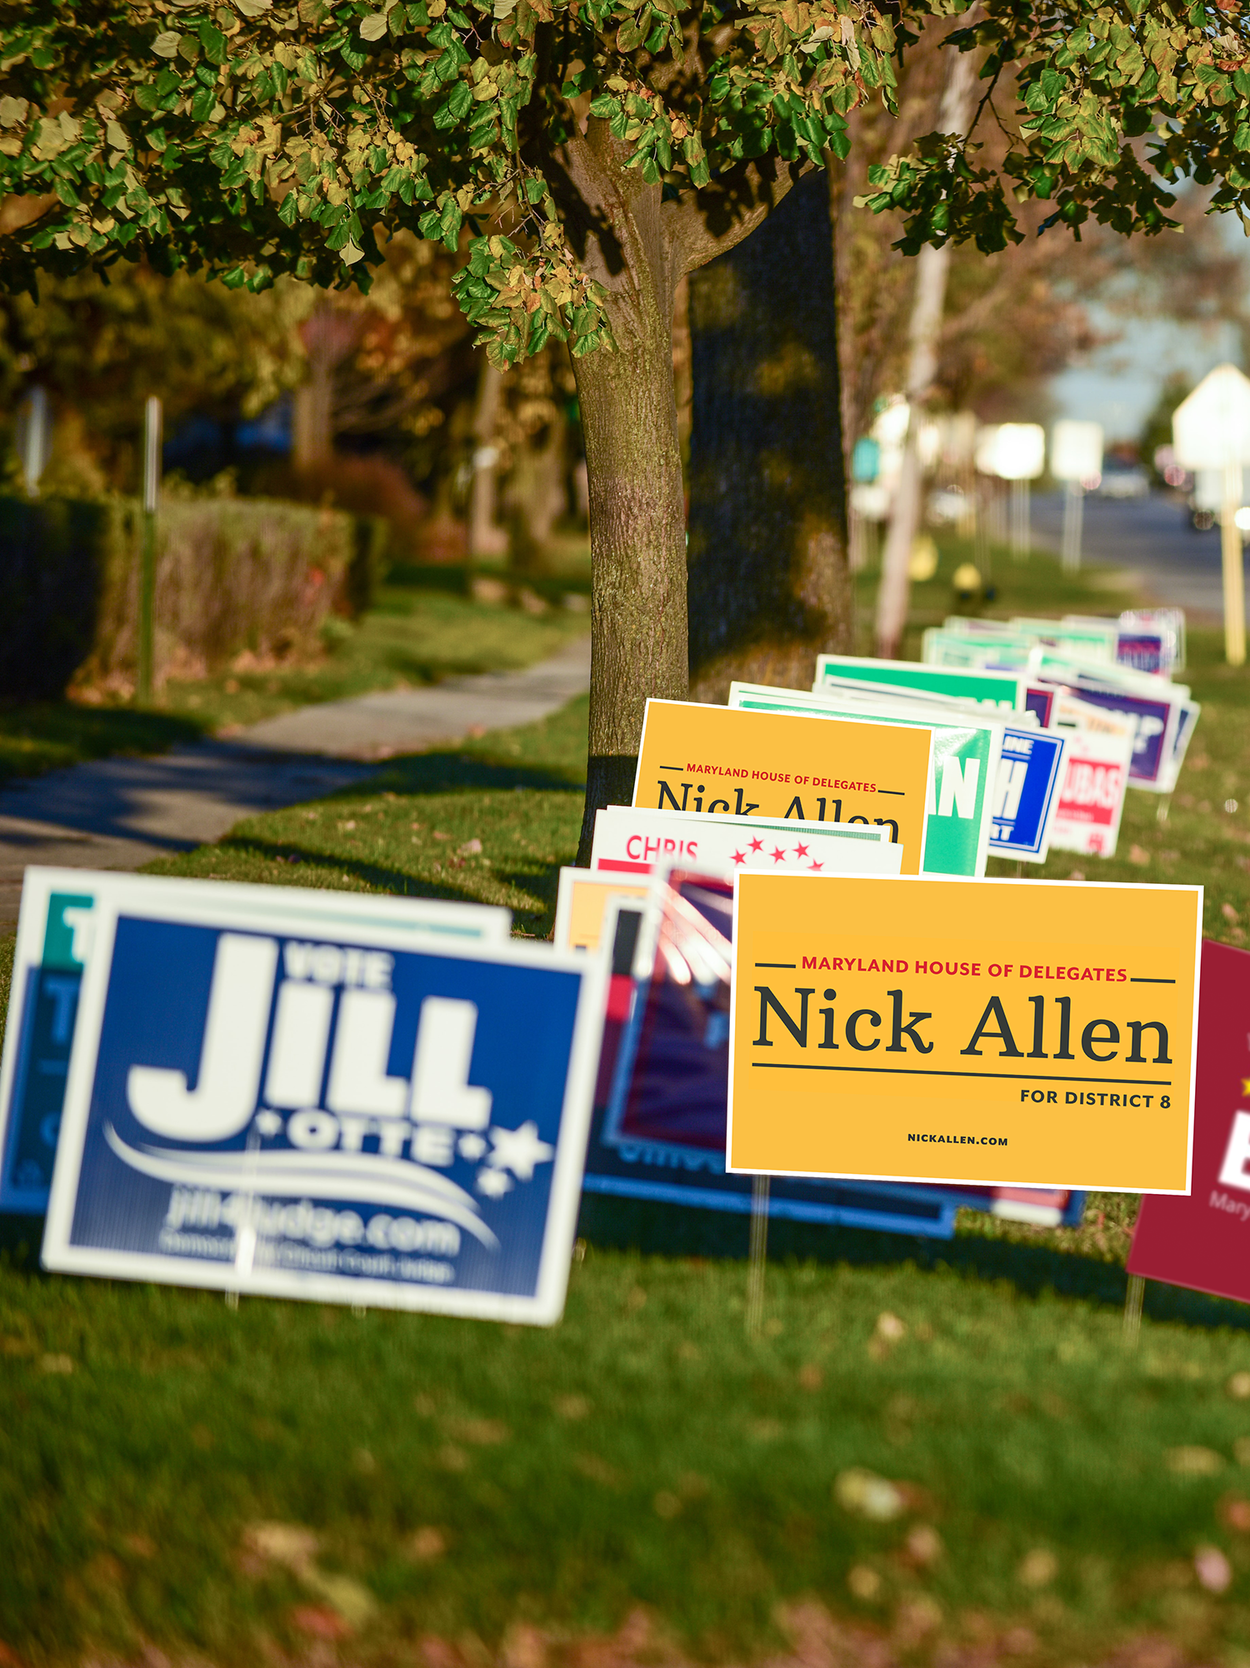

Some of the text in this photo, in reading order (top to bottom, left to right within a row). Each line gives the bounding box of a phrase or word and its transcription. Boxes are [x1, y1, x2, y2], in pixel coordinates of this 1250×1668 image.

[686, 762, 877, 793] MARYLAND HOUSE OF DELEGATES
[626, 834, 698, 864] CHRIS
[282, 939, 395, 991] VOTE
[801, 956, 1127, 982] MARYLAND HOUSE OF DELEGATES
[752, 985, 1173, 1065] Nick Allen
[1020, 1089, 1171, 1109] FOR DISTRICT 8
[286, 1108, 456, 1167] OTTE
[907, 1133, 1008, 1146] NICKALLEN.COM
